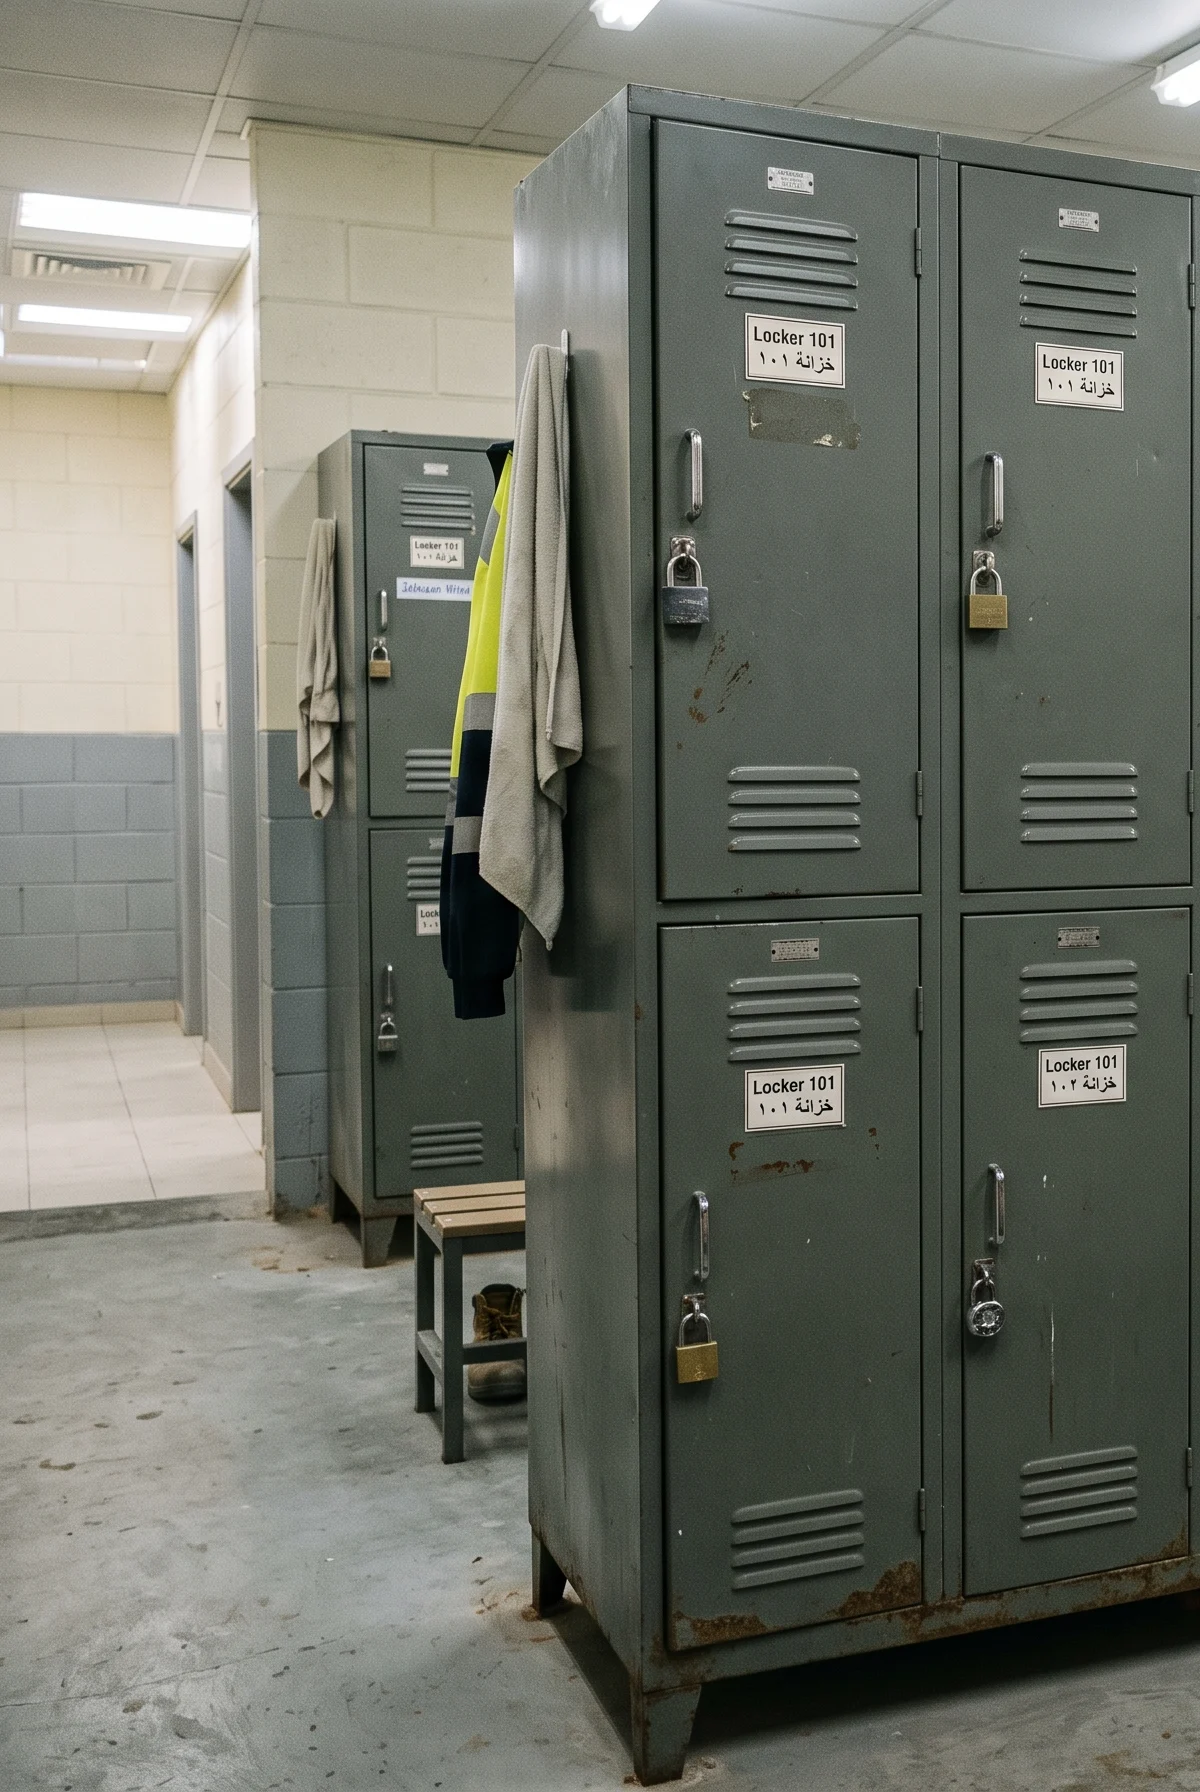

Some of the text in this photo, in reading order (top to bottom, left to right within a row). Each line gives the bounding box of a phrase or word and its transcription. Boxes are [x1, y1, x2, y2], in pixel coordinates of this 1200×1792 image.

[754, 326, 835, 349] Locker 101
[760, 351, 835, 374] خزانة ١٠١
[1042, 354, 1115, 374] Locker 101
[1048, 377, 1115, 398] خزانة ١٠١
[420, 910, 439, 918] Lock
[1046, 1055, 1117, 1073] Locker 101
[753, 1075, 835, 1095] Locker 101
[1082, 1074, 1117, 1093] خزانة
[759, 1096, 833, 1116] خزانة ١٠١
